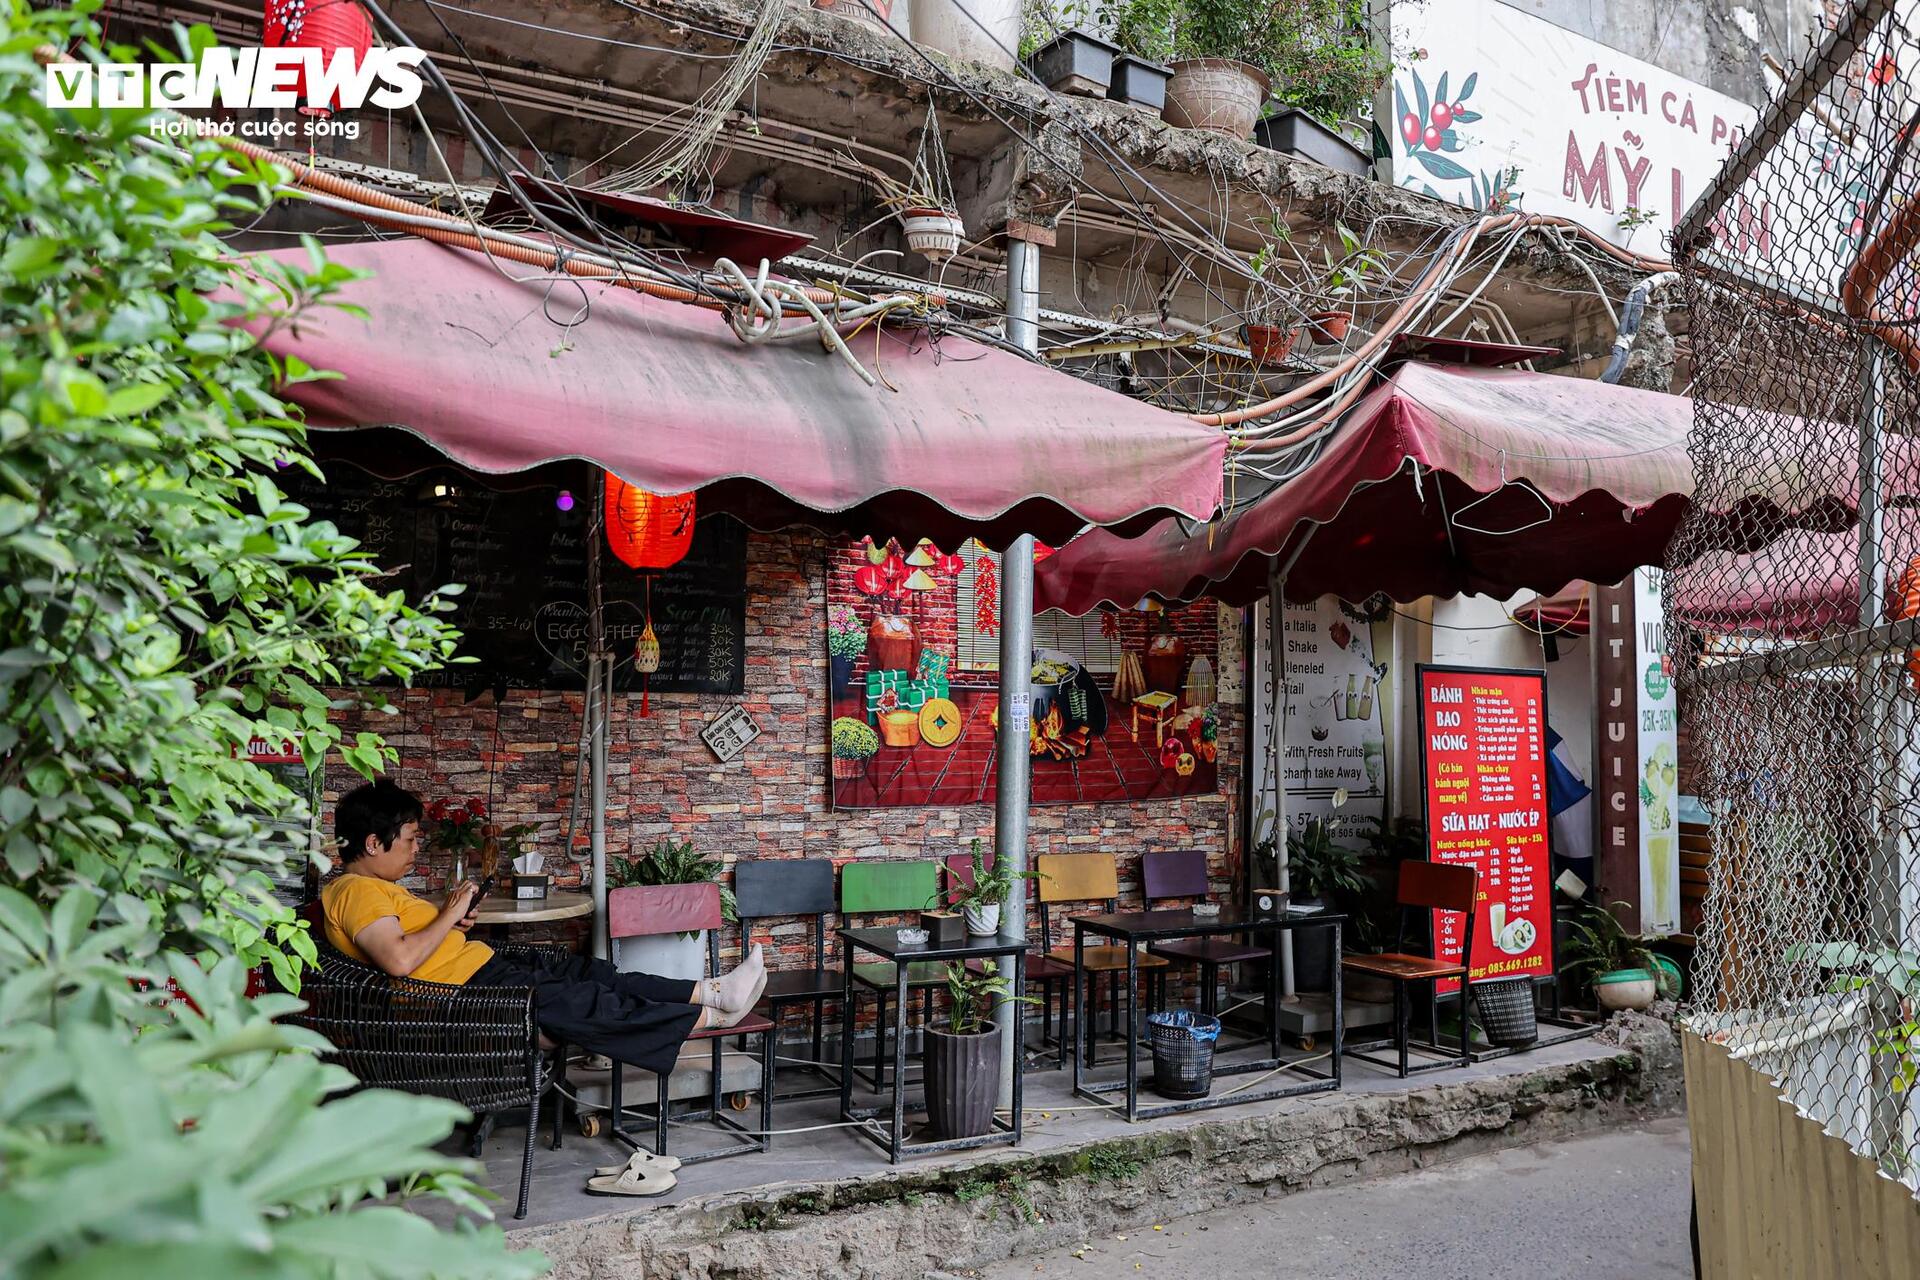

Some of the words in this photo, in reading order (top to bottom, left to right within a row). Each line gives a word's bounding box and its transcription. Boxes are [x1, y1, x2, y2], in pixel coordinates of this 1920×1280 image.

[1571, 62, 1648, 121] TIỆM
[1661, 92, 1698, 134] CÀ
[1563, 129, 1653, 218] MỸ
[547, 623, 579, 640] EGG
[582, 622, 641, 640] CFFEE
[1294, 619, 1317, 633] Italia
[1288, 639, 1318, 654] Shake
[1431, 684, 1463, 704] BÁNH
[1436, 710, 1461, 728] BAO
[1431, 731, 1469, 752] NÓNG
[1308, 746, 1334, 758] Fresh
[1337, 746, 1364, 758] Fruits
[1315, 767, 1334, 779] take
[1336, 766, 1362, 781] Away
[1438, 762, 1451, 775] (Có
[1451, 762, 1463, 774] bán
[1477, 764, 1494, 774] Nhân
[1494, 765, 1510, 775] chay
[1608, 687, 1626, 847] JUICE
[1435, 777, 1452, 788] bánh
[1439, 793, 1457, 804] mang
[1298, 812, 1312, 826] 57
[1441, 811, 1466, 832] SỮA
[1468, 814, 1491, 833] HẠT
[1498, 808, 1528, 829] NƯỚC
[1528, 808, 1540, 827] ÉP
[1436, 840, 1456, 851] Nước
[1457, 839, 1475, 850] uống
[1475, 837, 1491, 848] khác
[1506, 834, 1518, 845] Sữa
[1518, 835, 1528, 846] hạt
[1441, 850, 1458, 860] Nước
[1444, 916, 1456, 925] Cóc
[1444, 925, 1452, 934] Ổi
[1469, 966, 1486, 979] àng:
[1487, 956, 1543, 975] 085.669.1282
